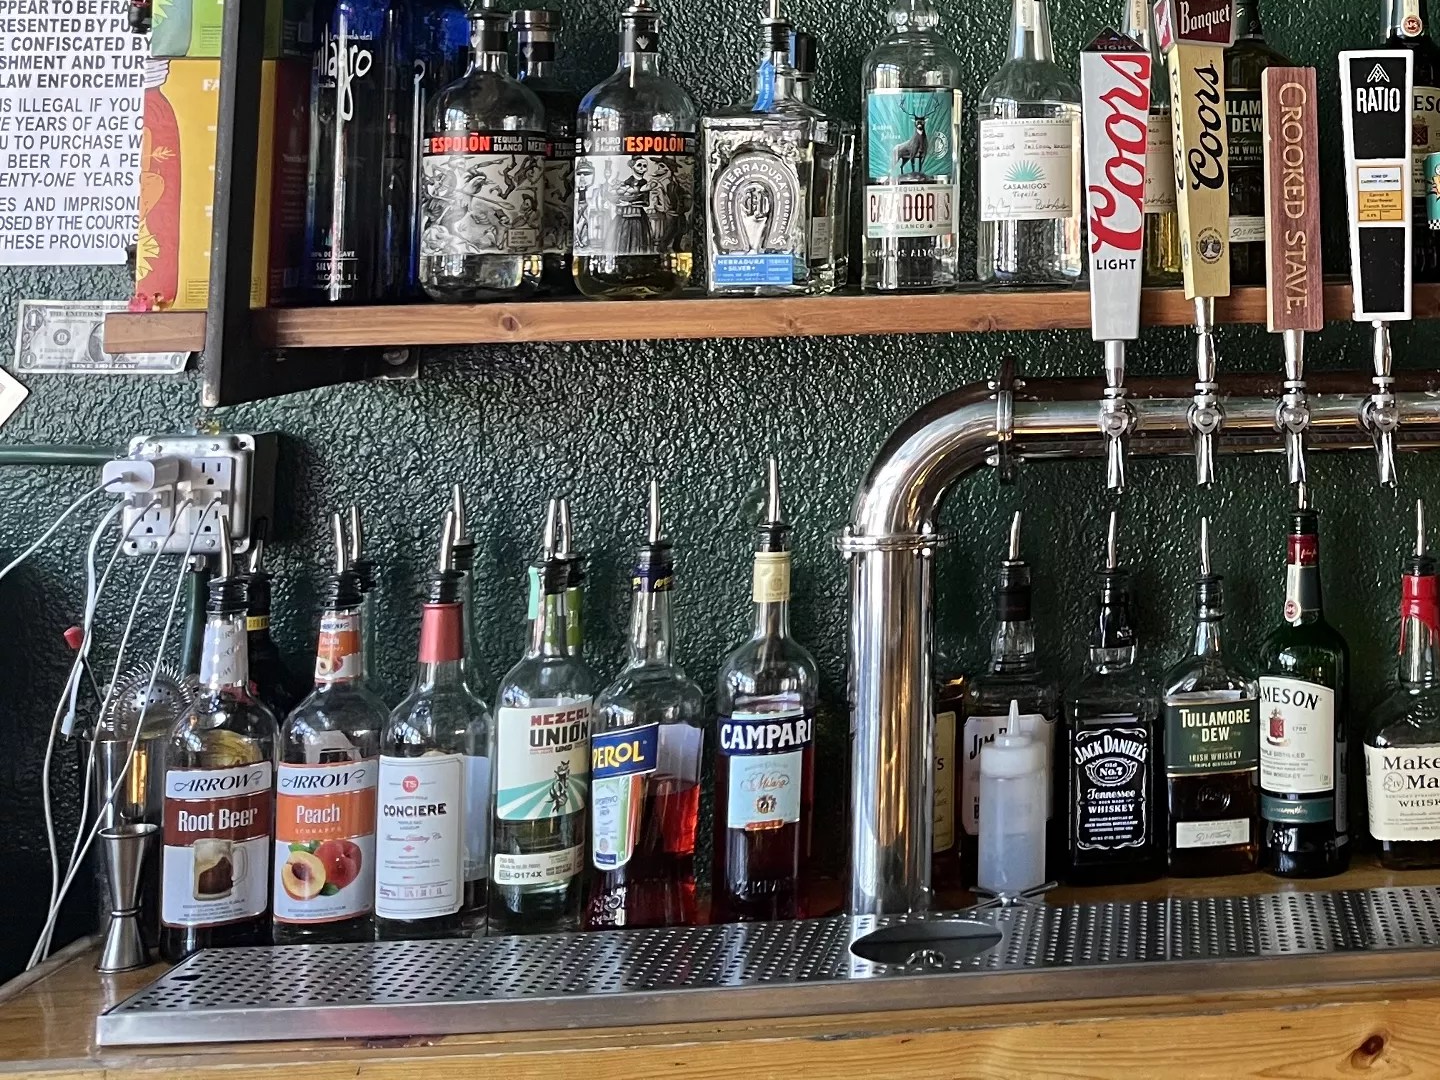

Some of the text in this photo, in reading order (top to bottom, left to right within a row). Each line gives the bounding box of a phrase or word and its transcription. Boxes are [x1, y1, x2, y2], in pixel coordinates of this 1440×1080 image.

[76, 0, 97, 15] BE
[1180, 1, 1232, 35] Banquet
[11, 37, 125, 52] CONFISCATED
[1097, 43, 1134, 52] LIGHT
[72, 55, 105, 70] AND
[0, 74, 31, 88] LAW
[19, 98, 141, 113] ILLEGAL YOU
[1356, 87, 1400, 114] RATIO
[16, 117, 130, 132] YEARS AGE
[1187, 60, 1223, 191] Coors
[40, 135, 123, 150] PURCHASE
[493, 135, 523, 143] TEQUILA
[493, 143, 523, 152] BLANCO
[1089, 54, 1151, 253] Coors
[1278, 82, 1308, 220] CROOKED
[7, 153, 91, 168] BEER FOR
[83, 172, 134, 187] YEARS
[721, 162, 789, 190] HERRADURA
[24, 197, 56, 212] AND
[57, 215, 139, 230] THE COURTS
[0, 234, 138, 249] THESE PROVISIONS
[1096, 258, 1137, 271] LIGHT
[531, 708, 589, 726] MEZCAL
[1179, 708, 1250, 728] TULLAMORE
[530, 721, 588, 748] UNIÓN
[720, 719, 812, 750] CAMPARI
[1202, 726, 1229, 742] DEW
[592, 741, 644, 770] PEROL
[1075, 735, 1148, 765] JACK DANIEL'S
[1189, 751, 1241, 762] IRISH WHISKEY
[174, 770, 262, 793] ARROW
[281, 769, 365, 788] ARROW
[404, 780, 418, 789] TS
[1087, 788, 1135, 800] Tennessee
[296, 803, 340, 825] Peach
[383, 803, 447, 818] CONCIERE
[1088, 804, 1135, 814] WHISKEY
[178, 807, 258, 832] Root Beer
